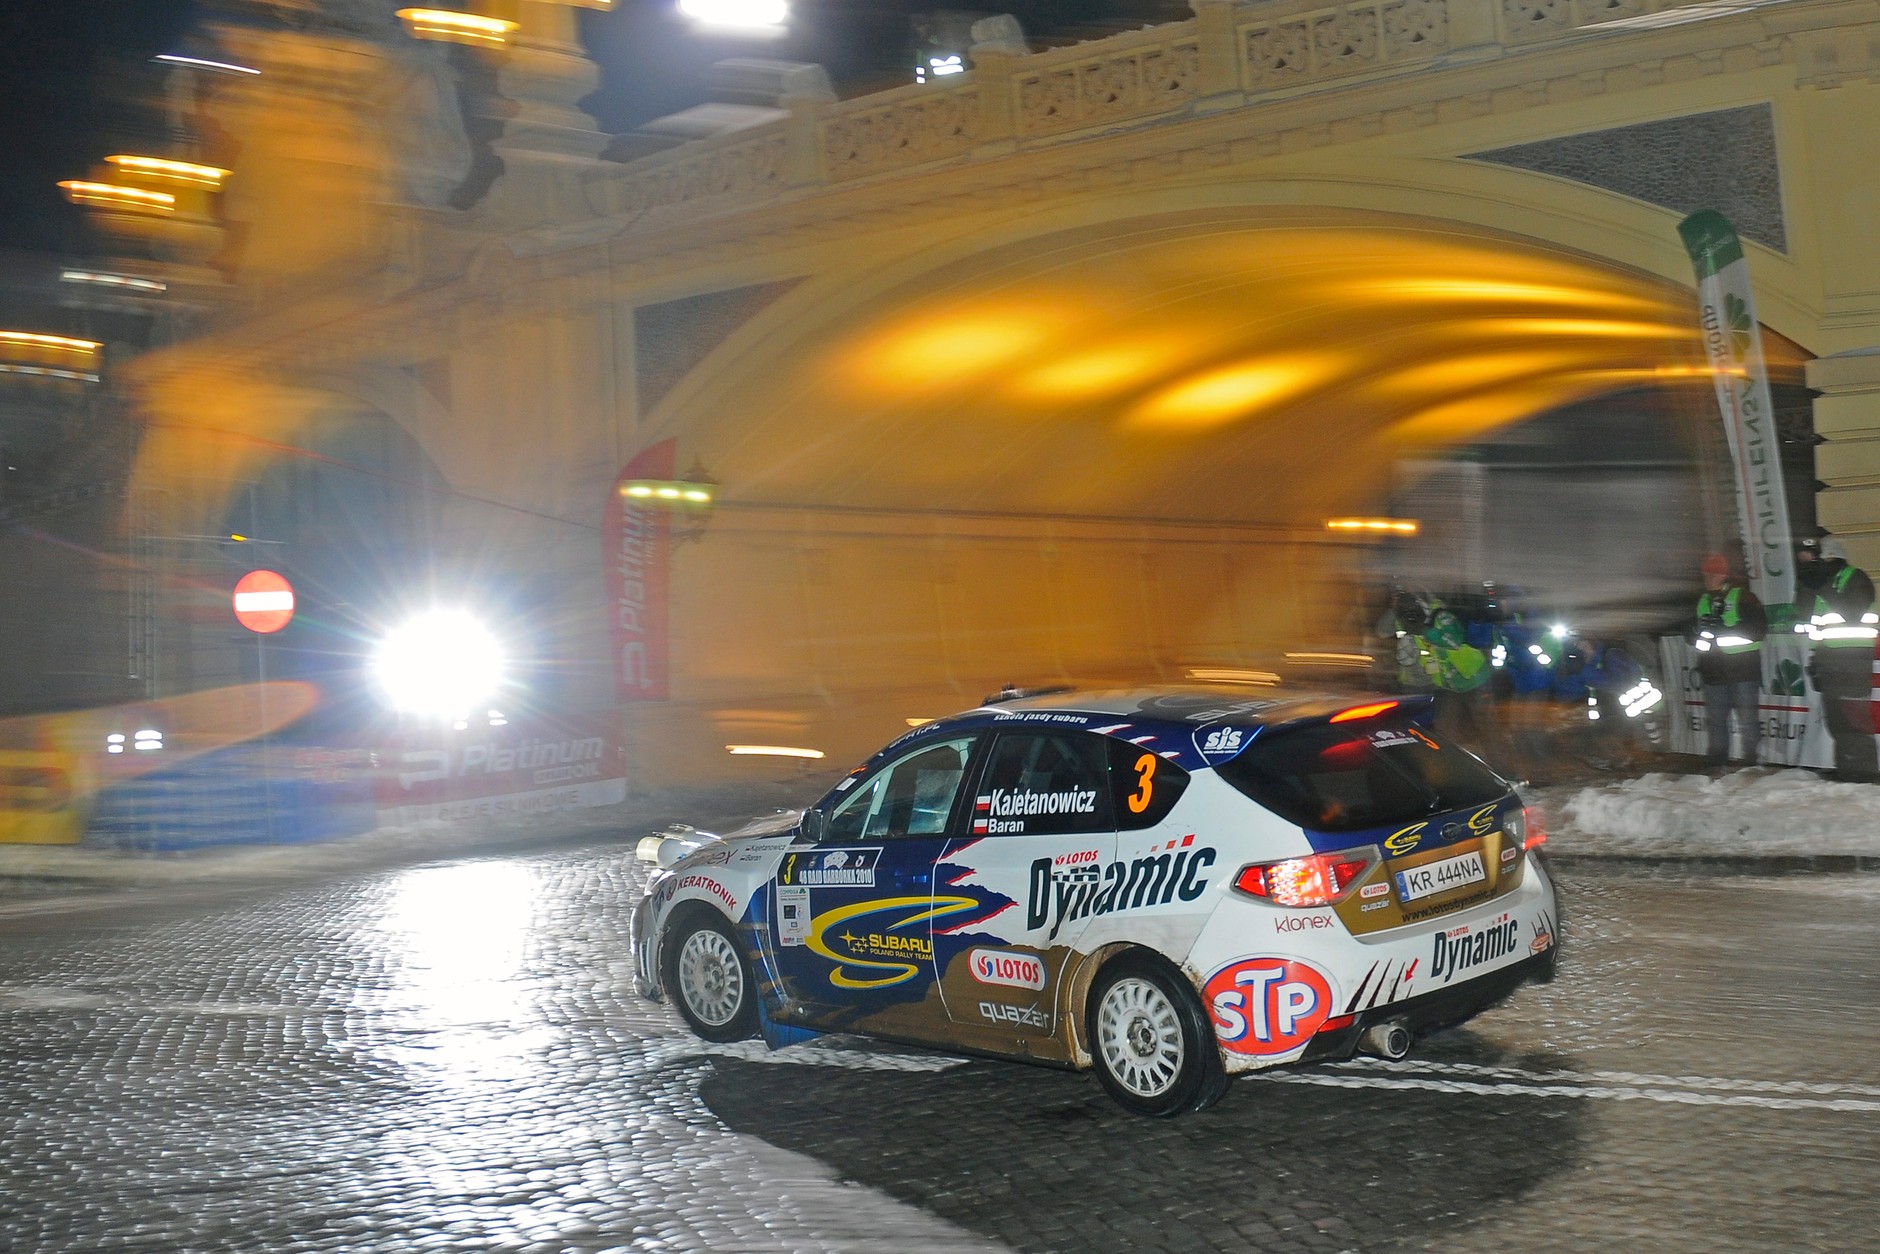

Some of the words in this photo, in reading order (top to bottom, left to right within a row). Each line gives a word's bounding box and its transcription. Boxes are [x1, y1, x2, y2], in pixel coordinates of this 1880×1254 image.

[1052, 714, 1088, 724] subaru
[459, 737, 603, 776] Platinum
[1128, 753, 1157, 813] 3
[990, 785, 1096, 817] Kajetanowicz
[988, 818, 1024, 833] Baran
[783, 853, 797, 885] 3
[1066, 850, 1099, 865] LOTOS
[856, 868, 872, 884] 2010
[1409, 871, 1434, 893] KR
[1437, 858, 1482, 884] 444NA
[677, 876, 737, 910] KERATRONIK
[1027, 846, 1217, 941] Dynamic
[1369, 884, 1388, 895] LOTOS
[1274, 913, 1334, 934] klonex
[1453, 925, 1469, 937] LOTOS
[869, 933, 932, 953] SUBARU
[870, 948, 894, 956] POLAND
[895, 950, 914, 960] RALLY
[915, 952, 933, 961] TEAM
[1431, 919, 1518, 983] Dynamic
[995, 957, 1039, 983] LOTOS
[979, 1001, 1049, 1029] quazar
[1214, 966, 1318, 1043] STP
